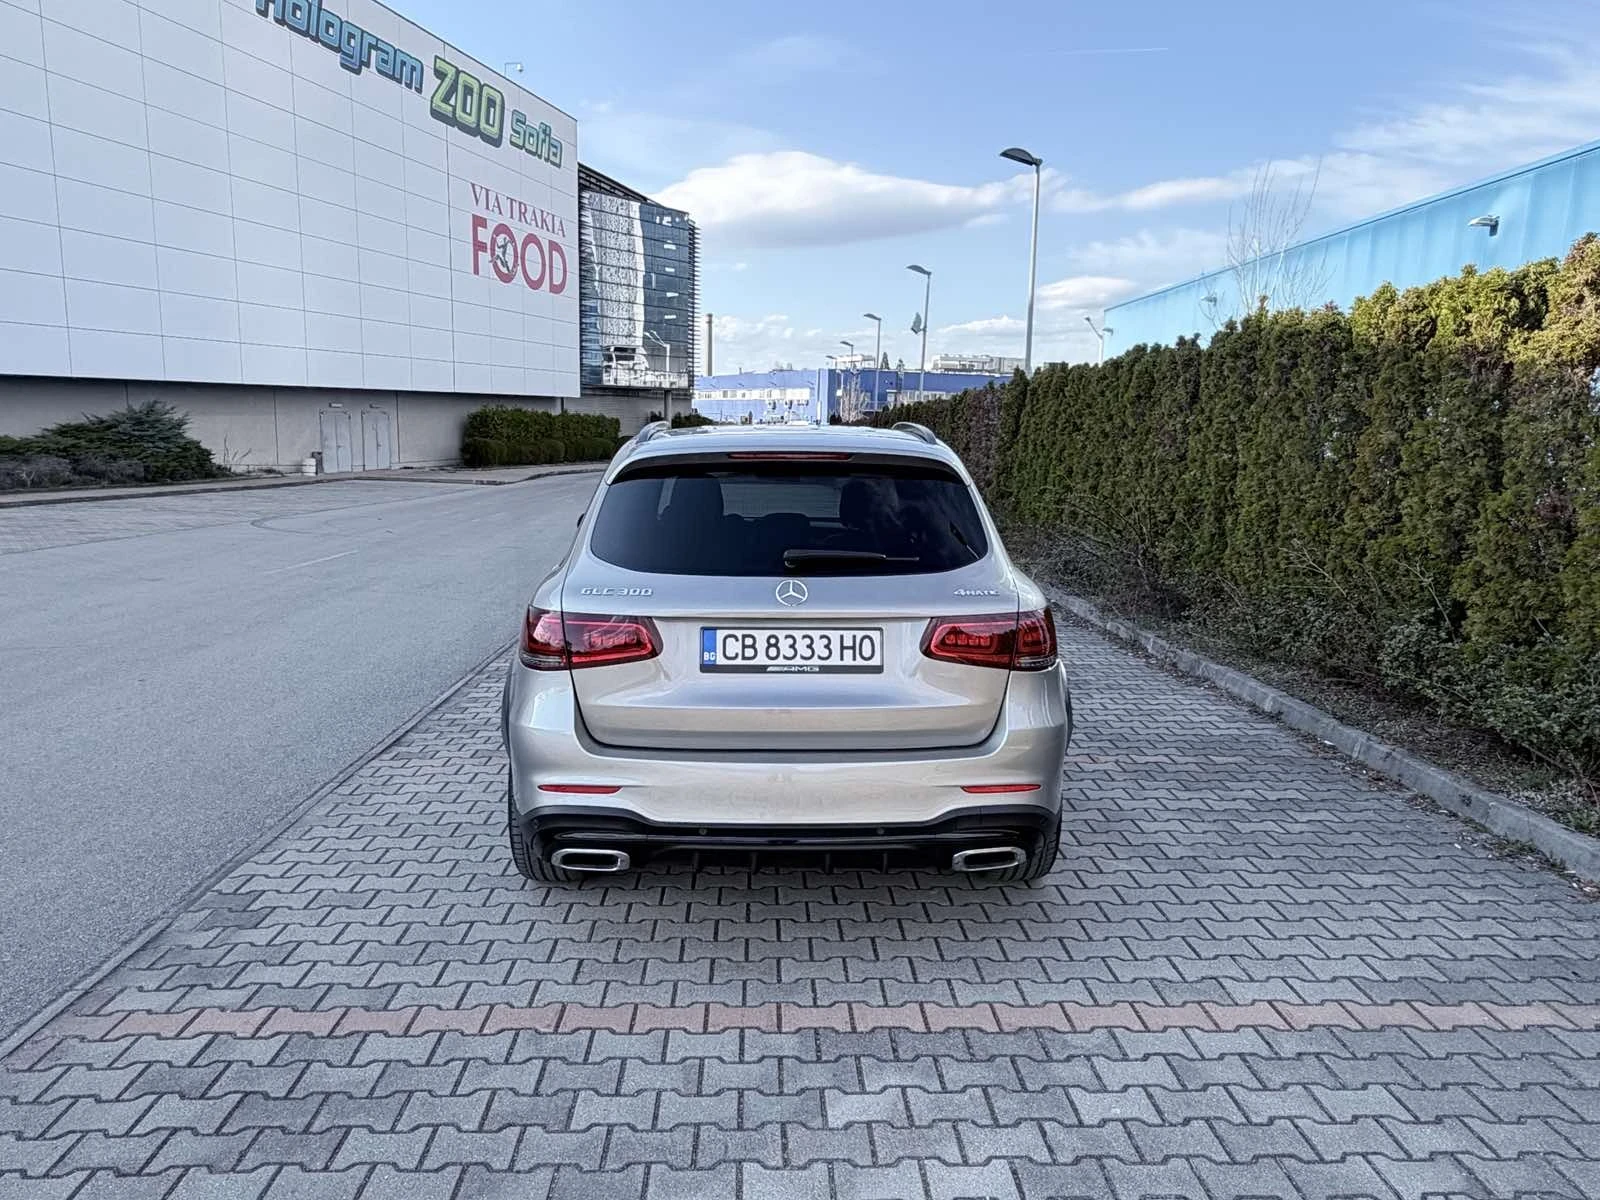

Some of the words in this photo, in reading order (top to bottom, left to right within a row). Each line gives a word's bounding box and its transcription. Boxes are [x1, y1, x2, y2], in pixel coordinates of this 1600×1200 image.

[430, 54, 505, 148] ZOO
[509, 109, 563, 168] Sofia
[470, 182, 503, 216] VIA
[506, 196, 566, 238] TRAKIA
[471, 213, 568, 295] FOOD
[581, 587, 616, 596] GLC
[616, 587, 654, 596] 300
[703, 651, 717, 661] BG
[722, 633, 758, 661] CB
[765, 633, 833, 661] 8333
[839, 634, 876, 662] HO
